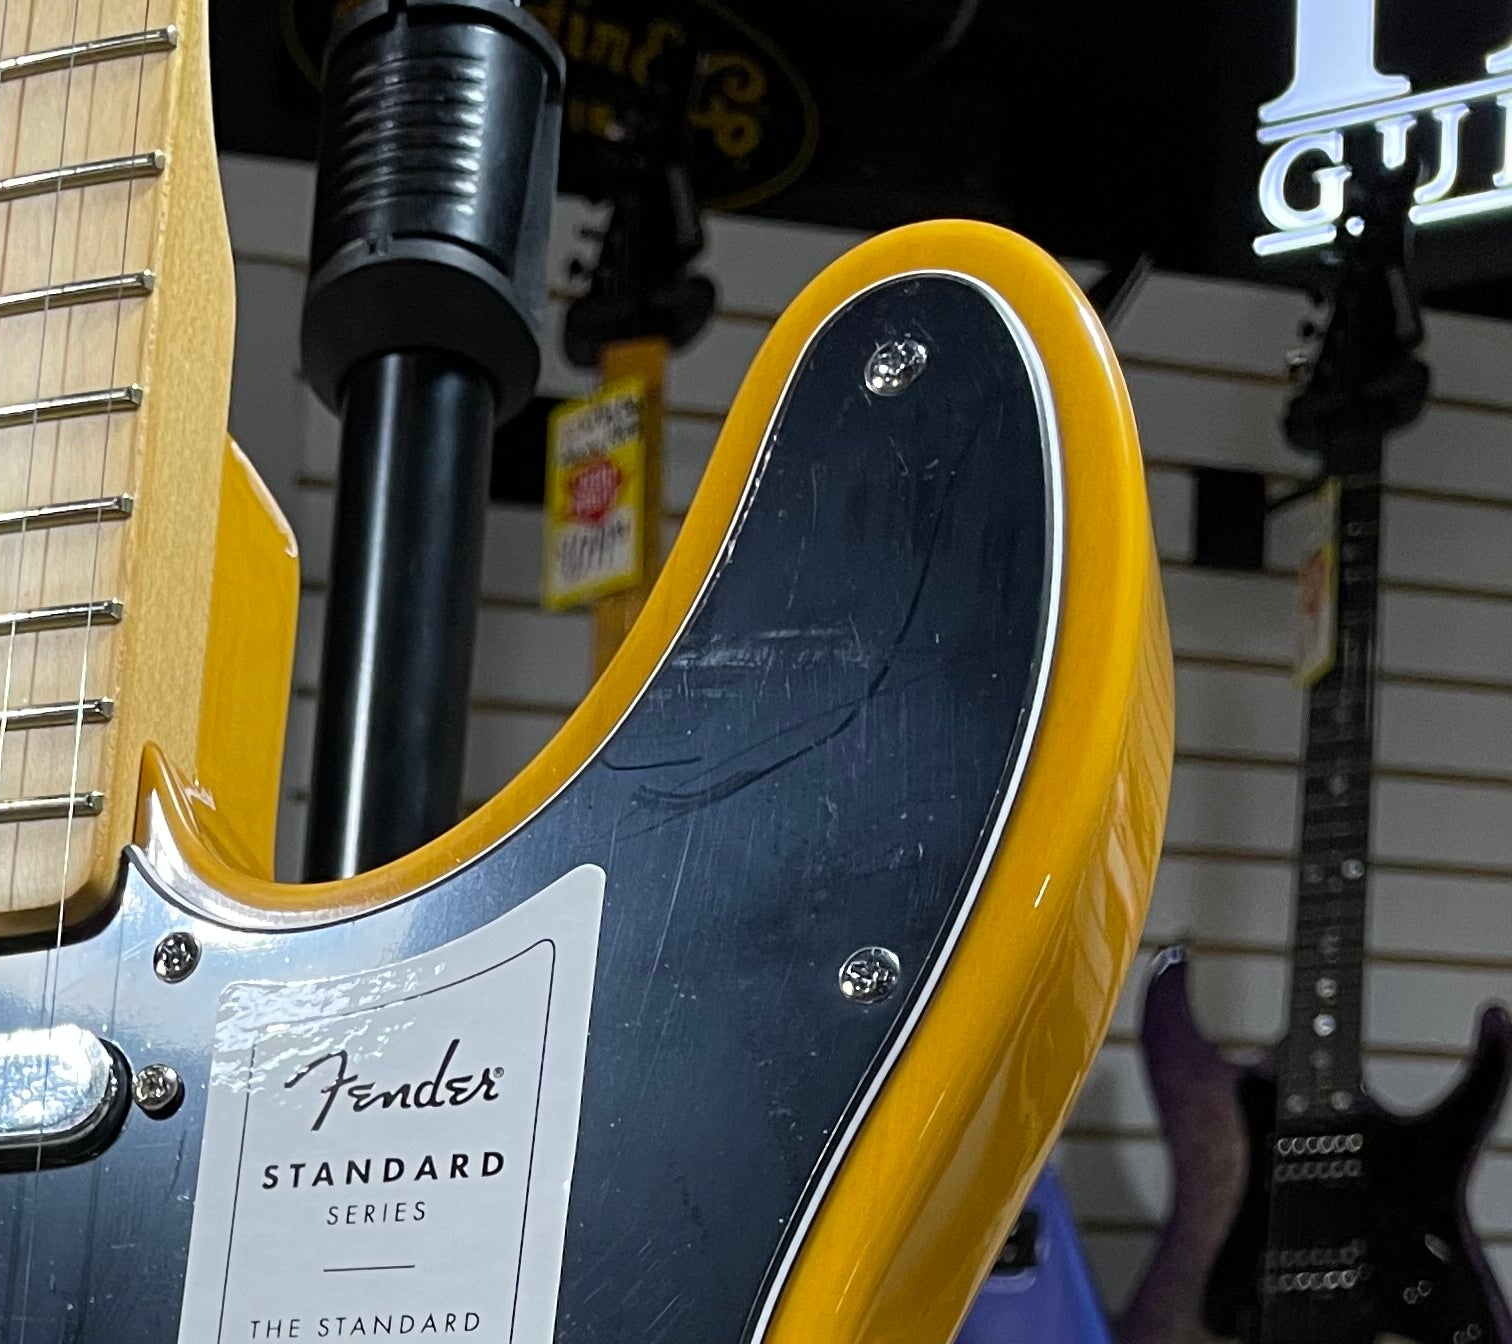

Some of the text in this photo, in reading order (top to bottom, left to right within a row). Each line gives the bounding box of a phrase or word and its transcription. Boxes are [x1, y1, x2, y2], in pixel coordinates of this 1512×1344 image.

[262, 1151, 504, 1190] STANDARD
[326, 1201, 426, 1226] SERIES
[250, 1312, 480, 1339] THE STANDARD
